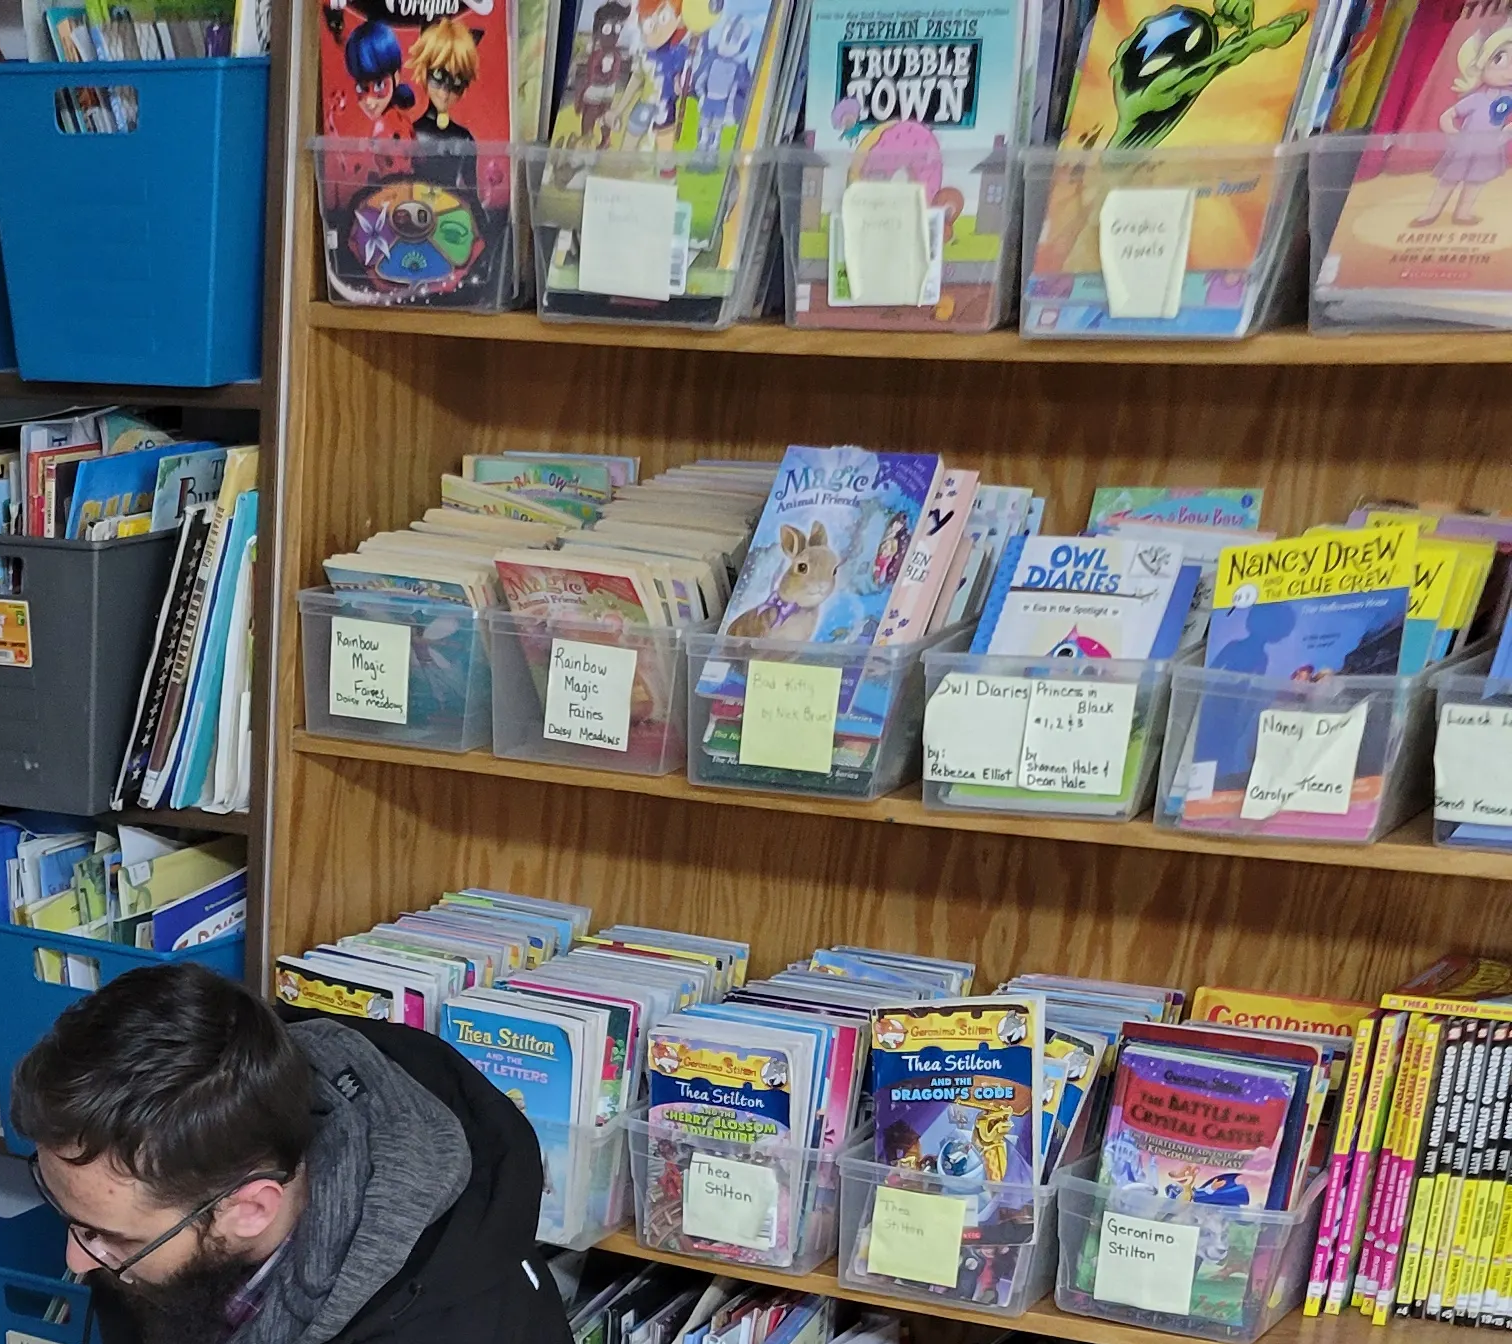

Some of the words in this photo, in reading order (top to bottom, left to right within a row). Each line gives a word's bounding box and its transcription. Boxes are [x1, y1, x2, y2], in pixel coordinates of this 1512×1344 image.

[844, 18, 919, 40] STEPHAN
[924, 18, 979, 38] PASTIS
[848, 44, 972, 79] TRUBBLE
[846, 76, 969, 123] TOWN
[1111, 218, 1166, 236] Graphic
[1459, 233, 1498, 244] PRIZE
[775, 465, 869, 500] Magic
[776, 493, 819, 514] Animal
[821, 492, 861, 508] Friends
[1050, 544, 1109, 572] OWL
[1323, 530, 1404, 575] DREW
[1023, 565, 1121, 593] DIARIES
[1287, 575, 1333, 597] CLUE
[1339, 564, 1397, 593] CREW
[336, 631, 379, 651] Rainbow
[352, 652, 386, 680] Magic
[554, 647, 607, 676] Rainbow
[564, 675, 599, 701] Magic
[976, 680, 1028, 699] Diaries
[1037, 682, 1083, 697] Princess
[1088, 687, 1097, 698] in
[569, 702, 604, 721] Fairies
[548, 723, 572, 739] Daisy
[579, 727, 620, 745] Meadows
[1262, 715, 1304, 740] Nancy
[930, 763, 976, 779] Rebecca
[982, 768, 1013, 781] Elliot
[1073, 760, 1099, 775] Hale
[1061, 777, 1087, 789] Hale
[1296, 775, 1343, 794] Keene
[1402, 999, 1428, 1010] THEA
[1434, 1003, 1477, 1013] STILTON
[453, 1020, 491, 1044] Thea
[497, 1028, 555, 1056] Stilton
[910, 1026, 956, 1037] Geronimo
[486, 1052, 505, 1062] AND
[507, 1055, 523, 1064] THE
[901, 1055, 942, 1072] Thea
[944, 1054, 1002, 1072] Stilton
[471, 1058, 489, 1073] OST
[493, 1062, 549, 1084] LETTERS
[931, 1078, 952, 1086] AND
[954, 1077, 973, 1086] THE
[675, 1081, 709, 1102] Thea
[712, 1089, 764, 1108] Stilton
[891, 1088, 970, 1101] DRAGON'S
[974, 1087, 1013, 1099] CODE
[1168, 1093, 1231, 1121] BATTLE
[663, 1110, 707, 1125] CHERRY
[713, 1116, 777, 1134] BLOSSOM
[1130, 1104, 1196, 1136] CRYSTAL
[692, 1160, 730, 1180] Thea
[705, 1181, 752, 1202] Stilton
[1107, 1218, 1175, 1244] Geronimo
[1109, 1242, 1155, 1262] Stilton
